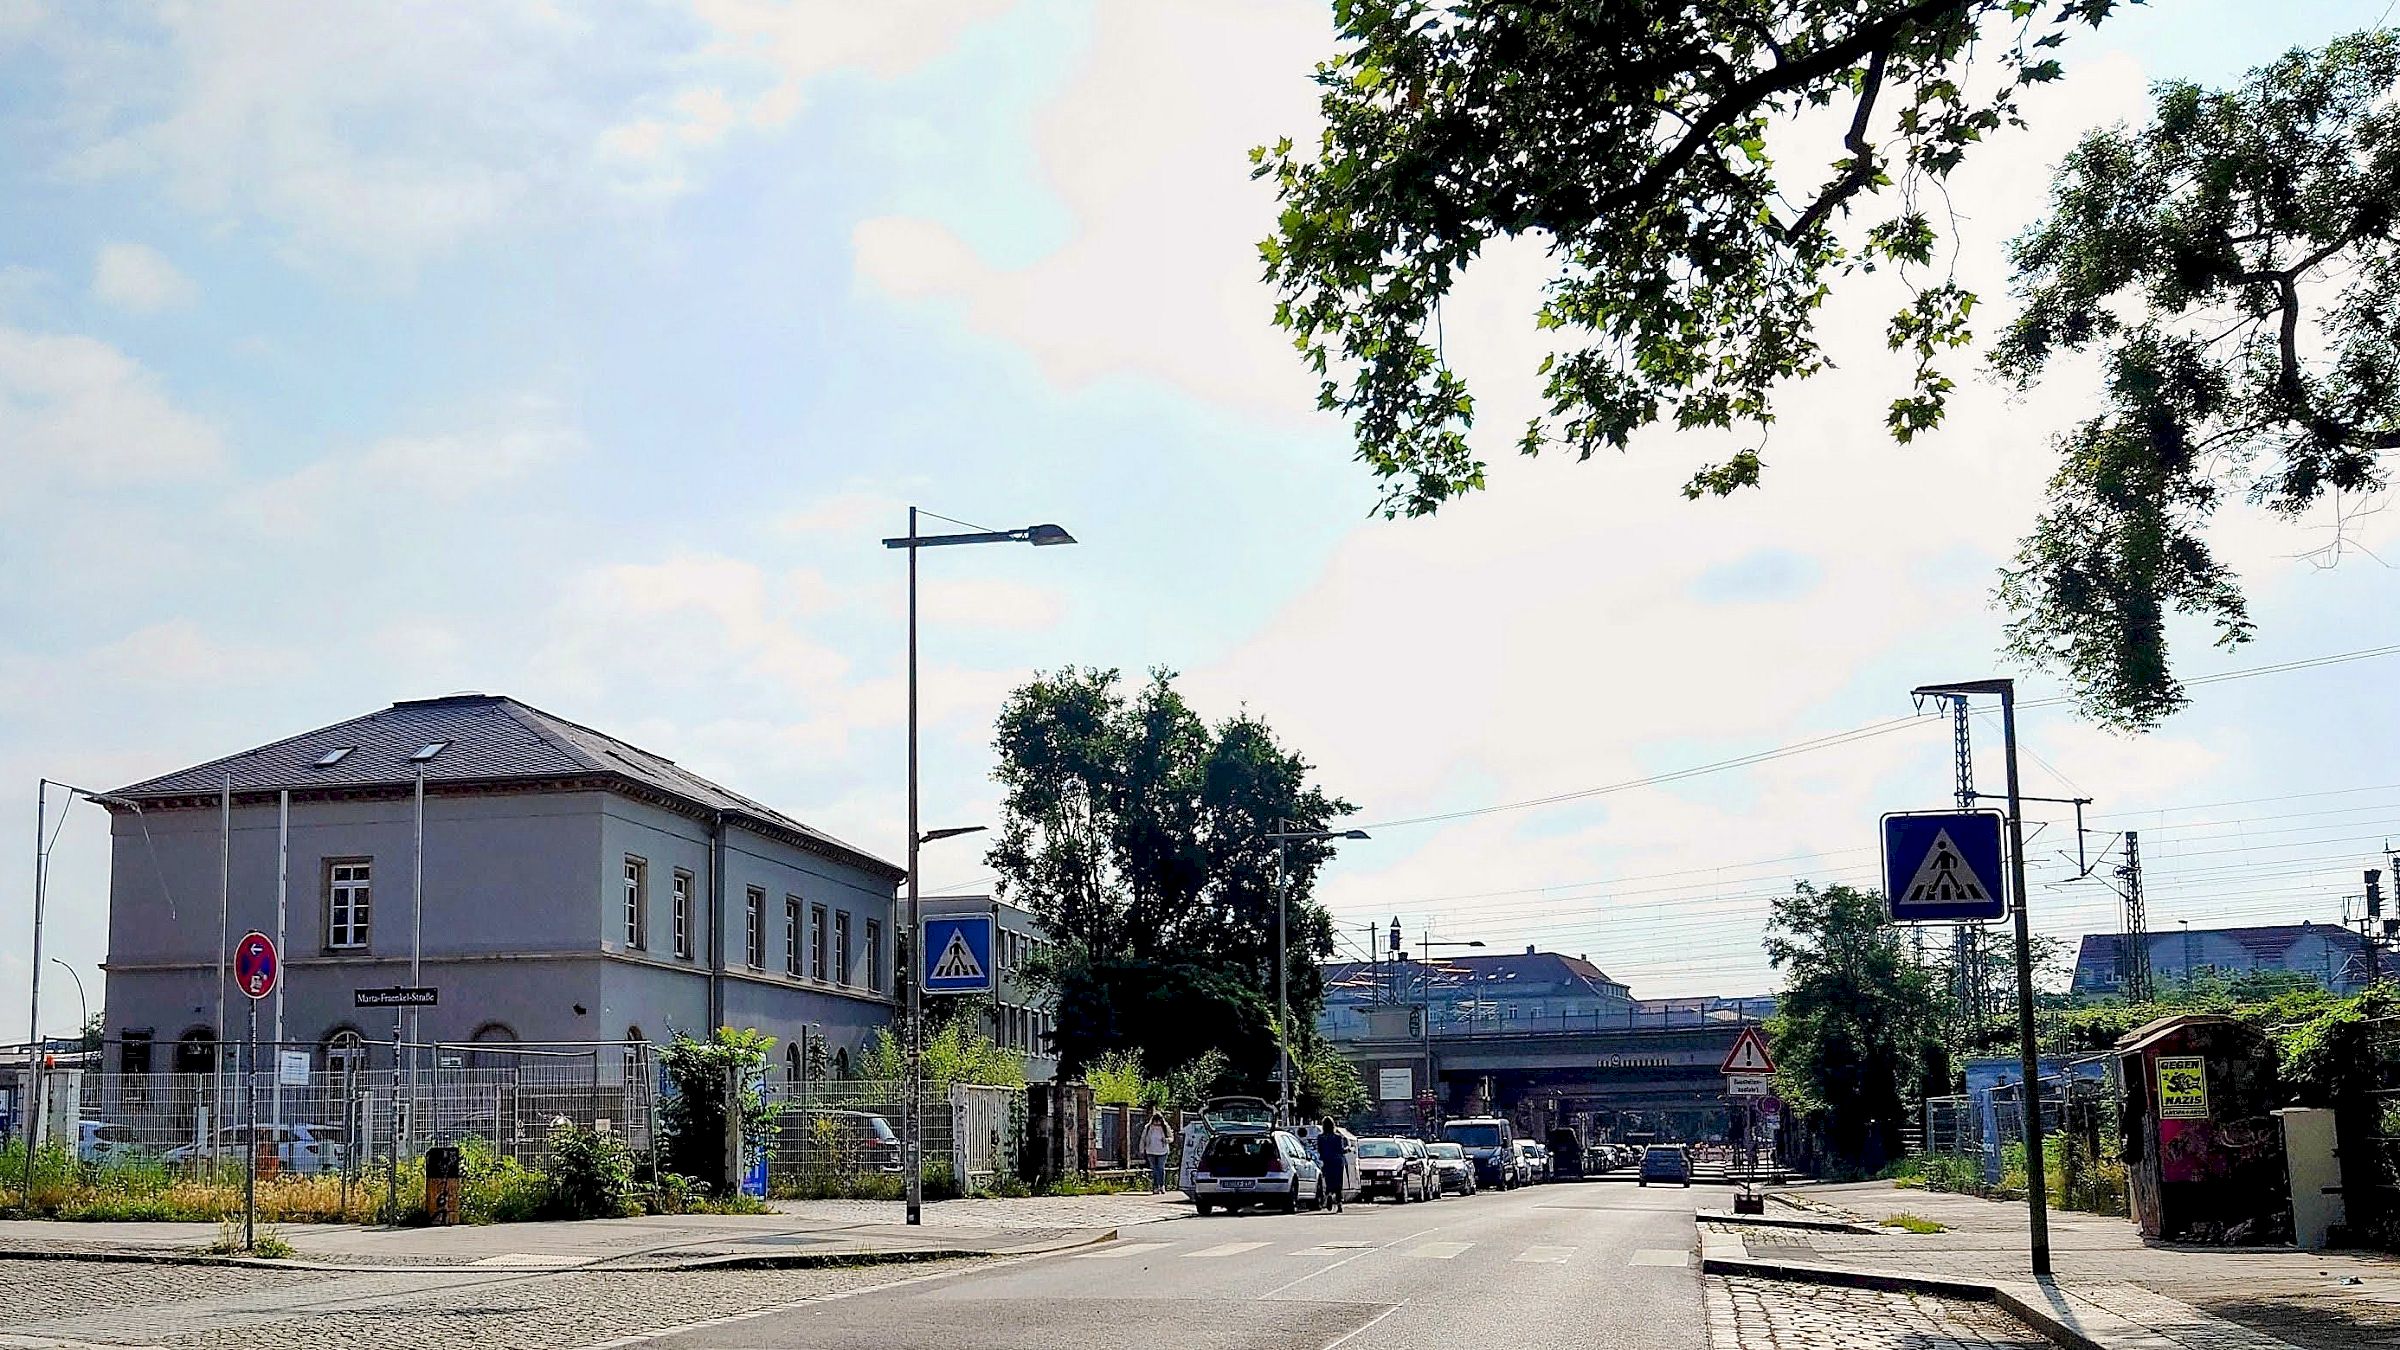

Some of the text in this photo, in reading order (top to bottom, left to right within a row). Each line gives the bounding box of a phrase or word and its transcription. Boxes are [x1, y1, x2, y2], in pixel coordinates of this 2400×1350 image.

[357, 992, 435, 1003] Marta-Fraenkel-Straße
[2161, 1061, 2199, 1069] GEGEN
[2165, 1096, 2202, 1104] NAZIS
